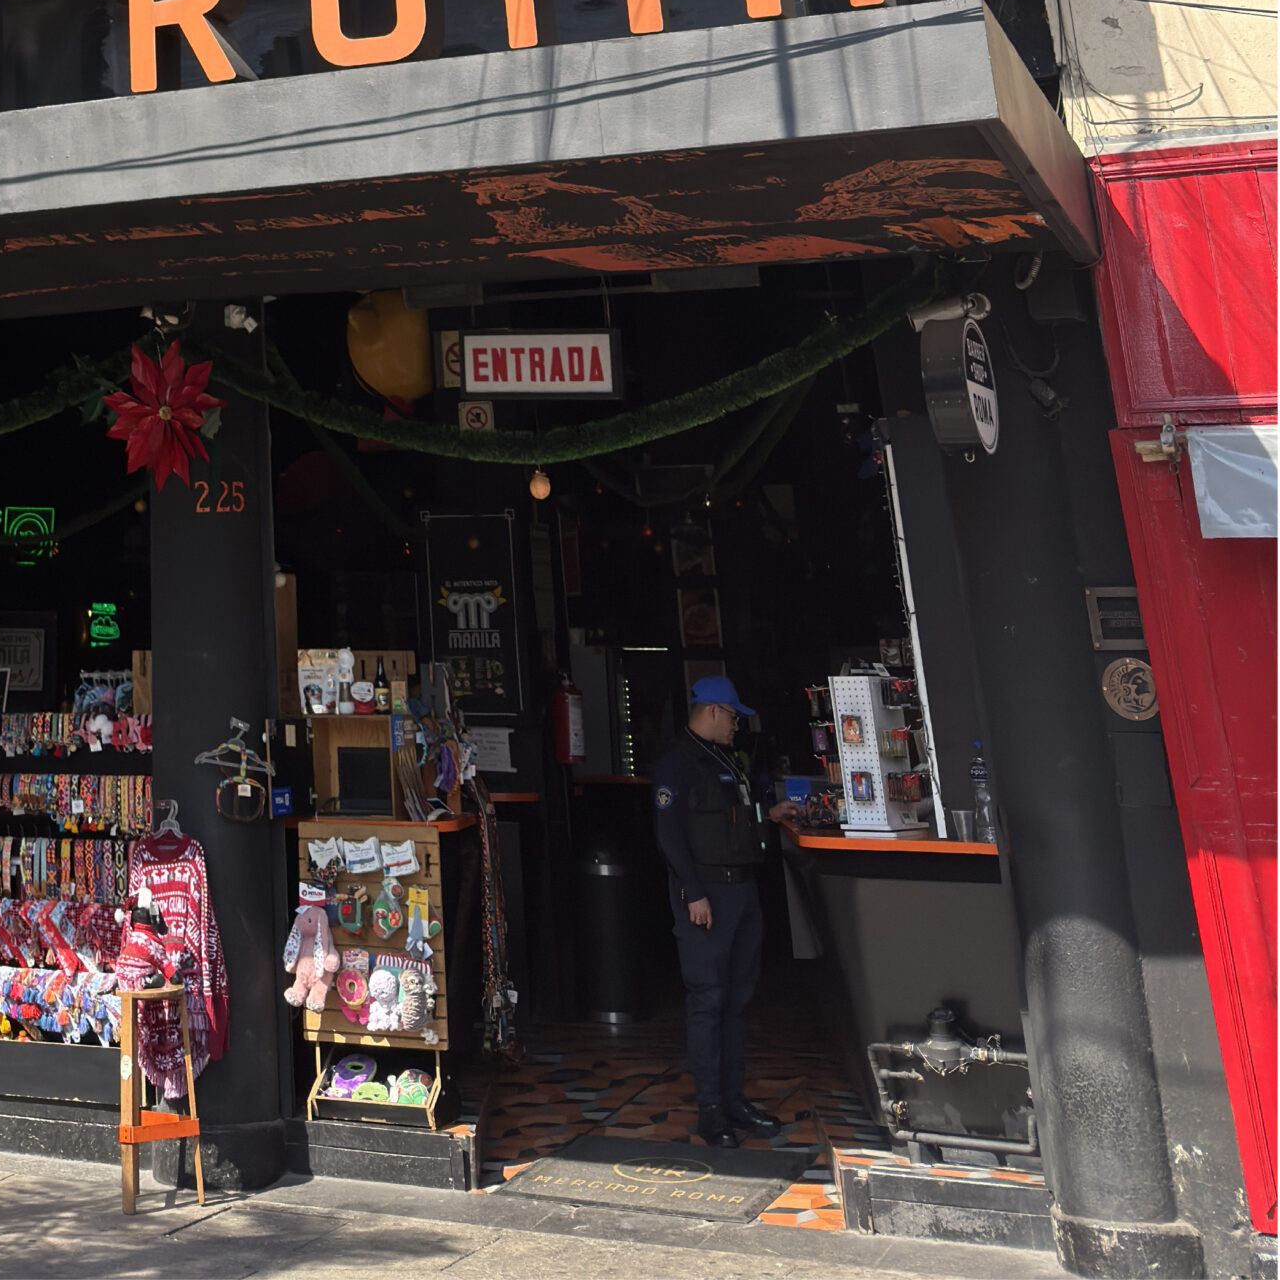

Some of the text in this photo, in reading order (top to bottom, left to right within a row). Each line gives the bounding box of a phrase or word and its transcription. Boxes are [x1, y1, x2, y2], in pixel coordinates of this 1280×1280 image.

[472, 346, 605, 382] ENTRADA
[966, 337, 986, 362] BARBER
[973, 393, 995, 426] ROMA
[194, 481, 246, 513] 225
[448, 632, 501, 649] MANILA
[533, 1175, 745, 1204] MERCADO ROMA
